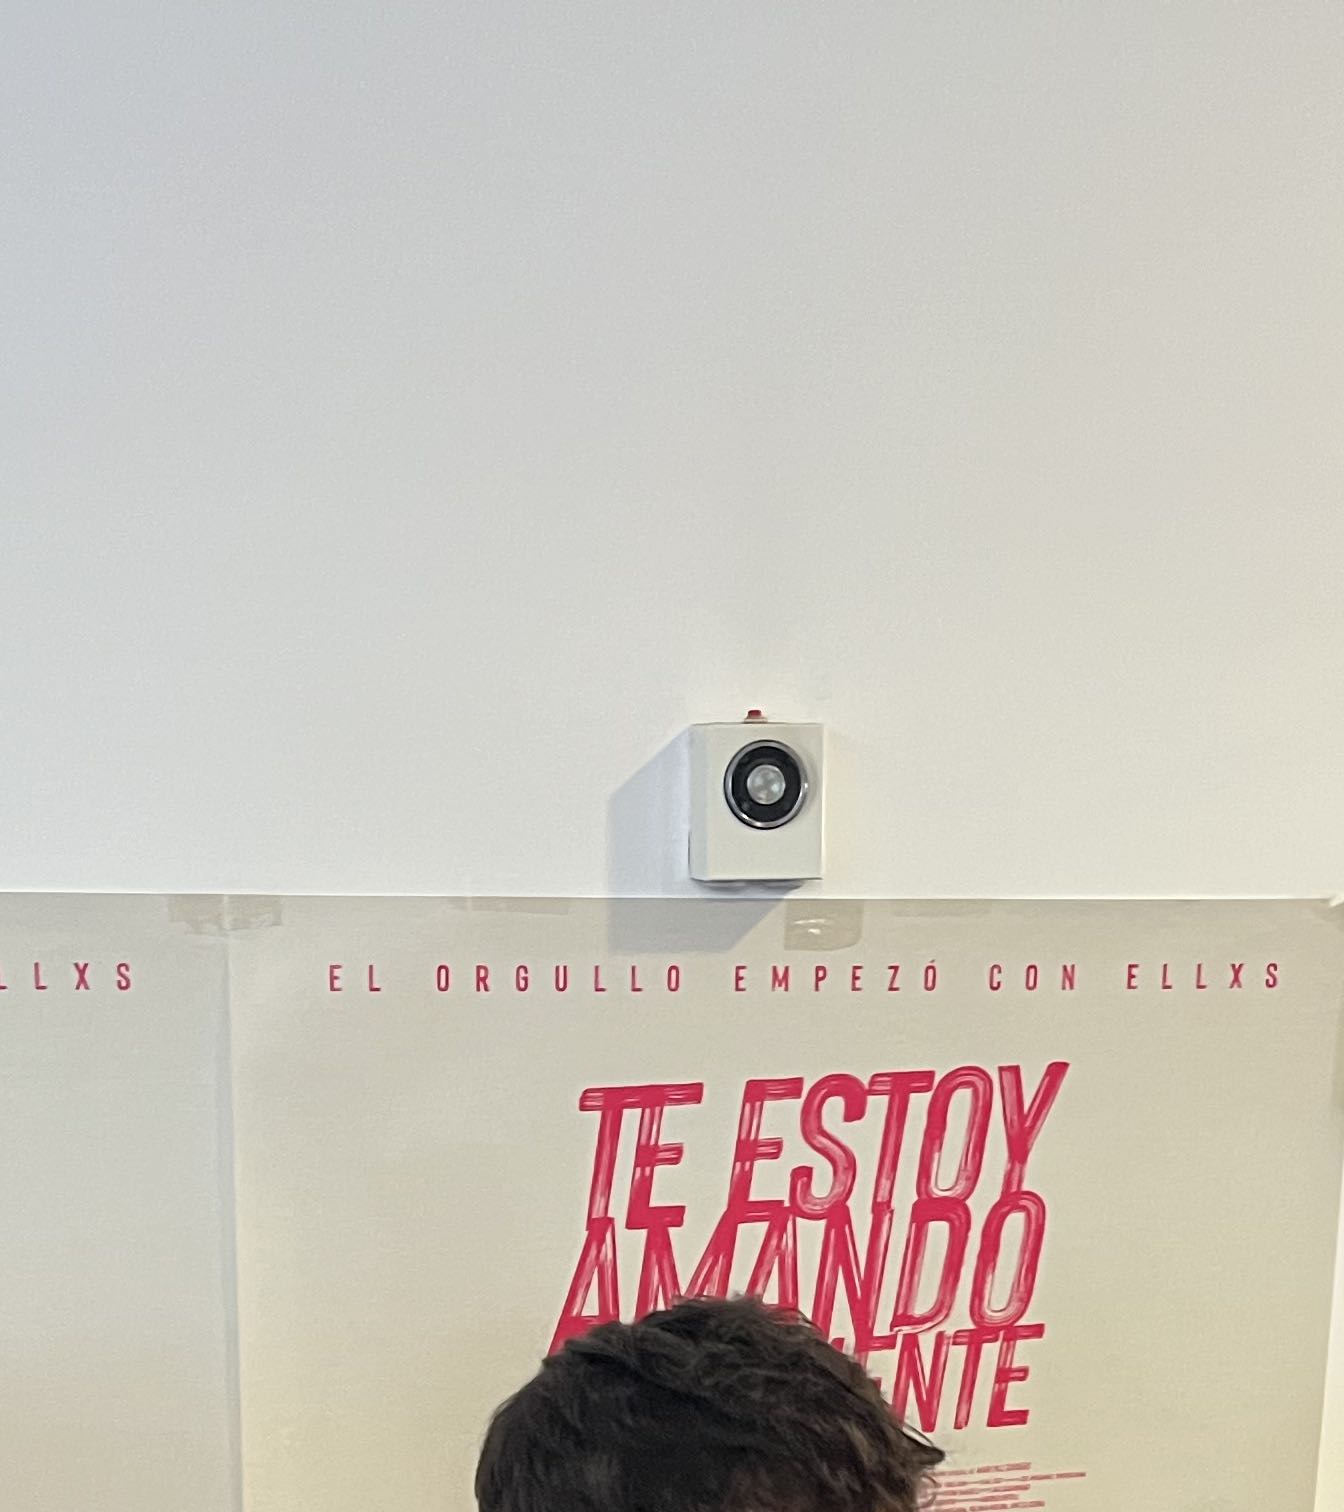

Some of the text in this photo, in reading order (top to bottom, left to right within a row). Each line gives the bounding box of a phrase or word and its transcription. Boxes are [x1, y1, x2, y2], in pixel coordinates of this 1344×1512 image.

[329, 957, 1281, 993] EL ORGULLO EMPEZÓ CON ELLXS
[578, 1061, 1070, 1230] TE ESTOY
